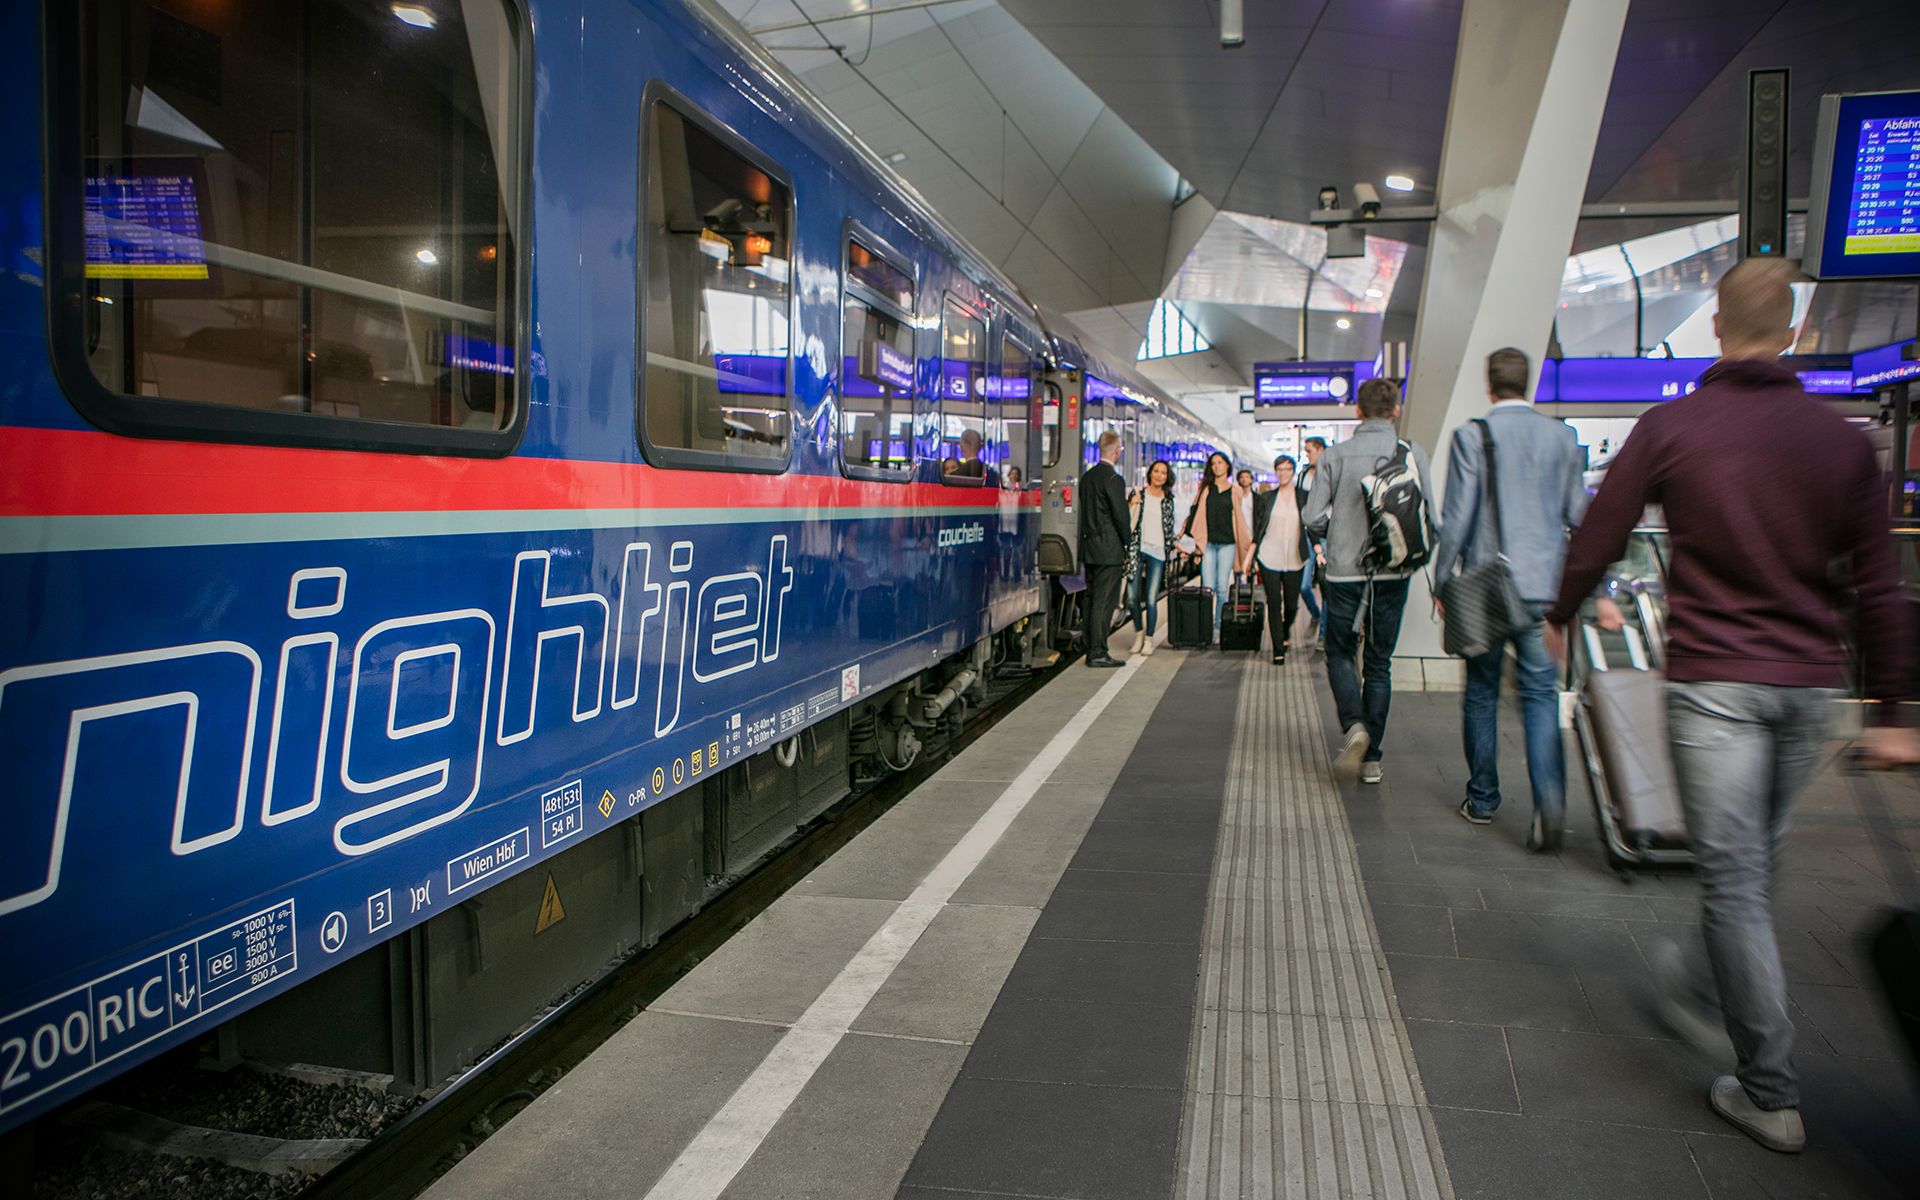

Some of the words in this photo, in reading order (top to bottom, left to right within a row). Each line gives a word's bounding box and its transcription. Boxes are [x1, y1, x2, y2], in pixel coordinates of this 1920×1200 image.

[938, 522, 984, 547] couchette
[0, 535, 793, 915] nightjet
[544, 796, 562, 814] 48t
[564, 788, 580, 805] 53t
[604, 798, 610, 812] R
[552, 821, 563, 837] 54
[463, 855, 493, 879] Wien
[496, 840, 516, 865] Hbf
[375, 901, 385, 921] 3
[244, 916, 266, 934] 1000
[267, 912, 275, 923] V
[245, 928, 267, 945] 1500
[268, 924, 276, 935] V
[246, 940, 268, 958] 1500
[269, 935, 276, 947] V
[211, 953, 234, 975] ee
[245, 952, 268, 971] 3000
[269, 947, 277, 959] V
[251, 968, 269, 985] 800
[270, 964, 278, 976] A
[99, 975, 165, 1042] RIC
[0, 1010, 91, 1091] 200
